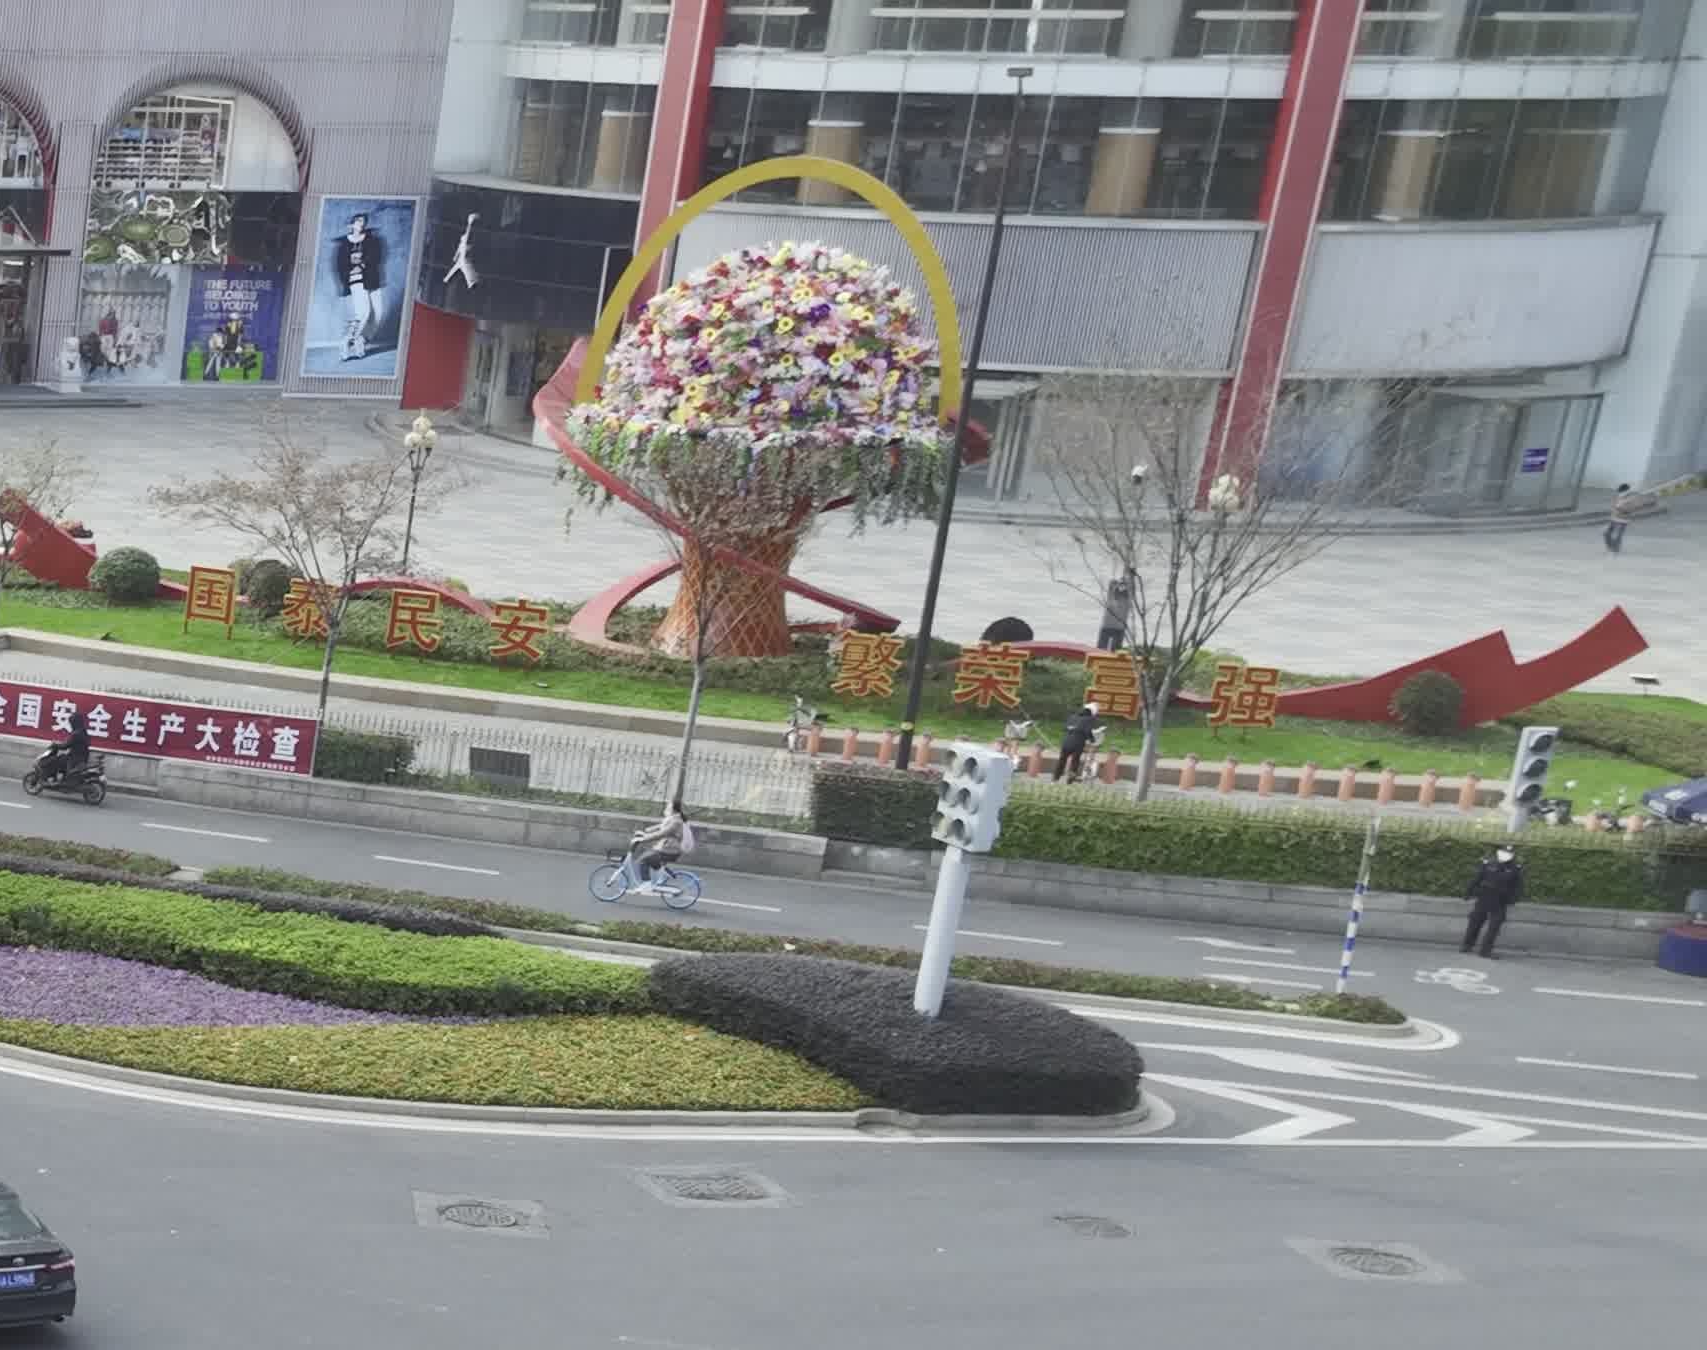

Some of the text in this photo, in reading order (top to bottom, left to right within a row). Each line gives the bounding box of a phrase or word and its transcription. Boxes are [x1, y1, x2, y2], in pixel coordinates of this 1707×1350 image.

[204, 301, 258, 311] TO YOUTH
[230, 279, 275, 290] FUTURE
[186, 565, 549, 662] 国泰民安
[830, 629, 1280, 729] 繁荣富强
